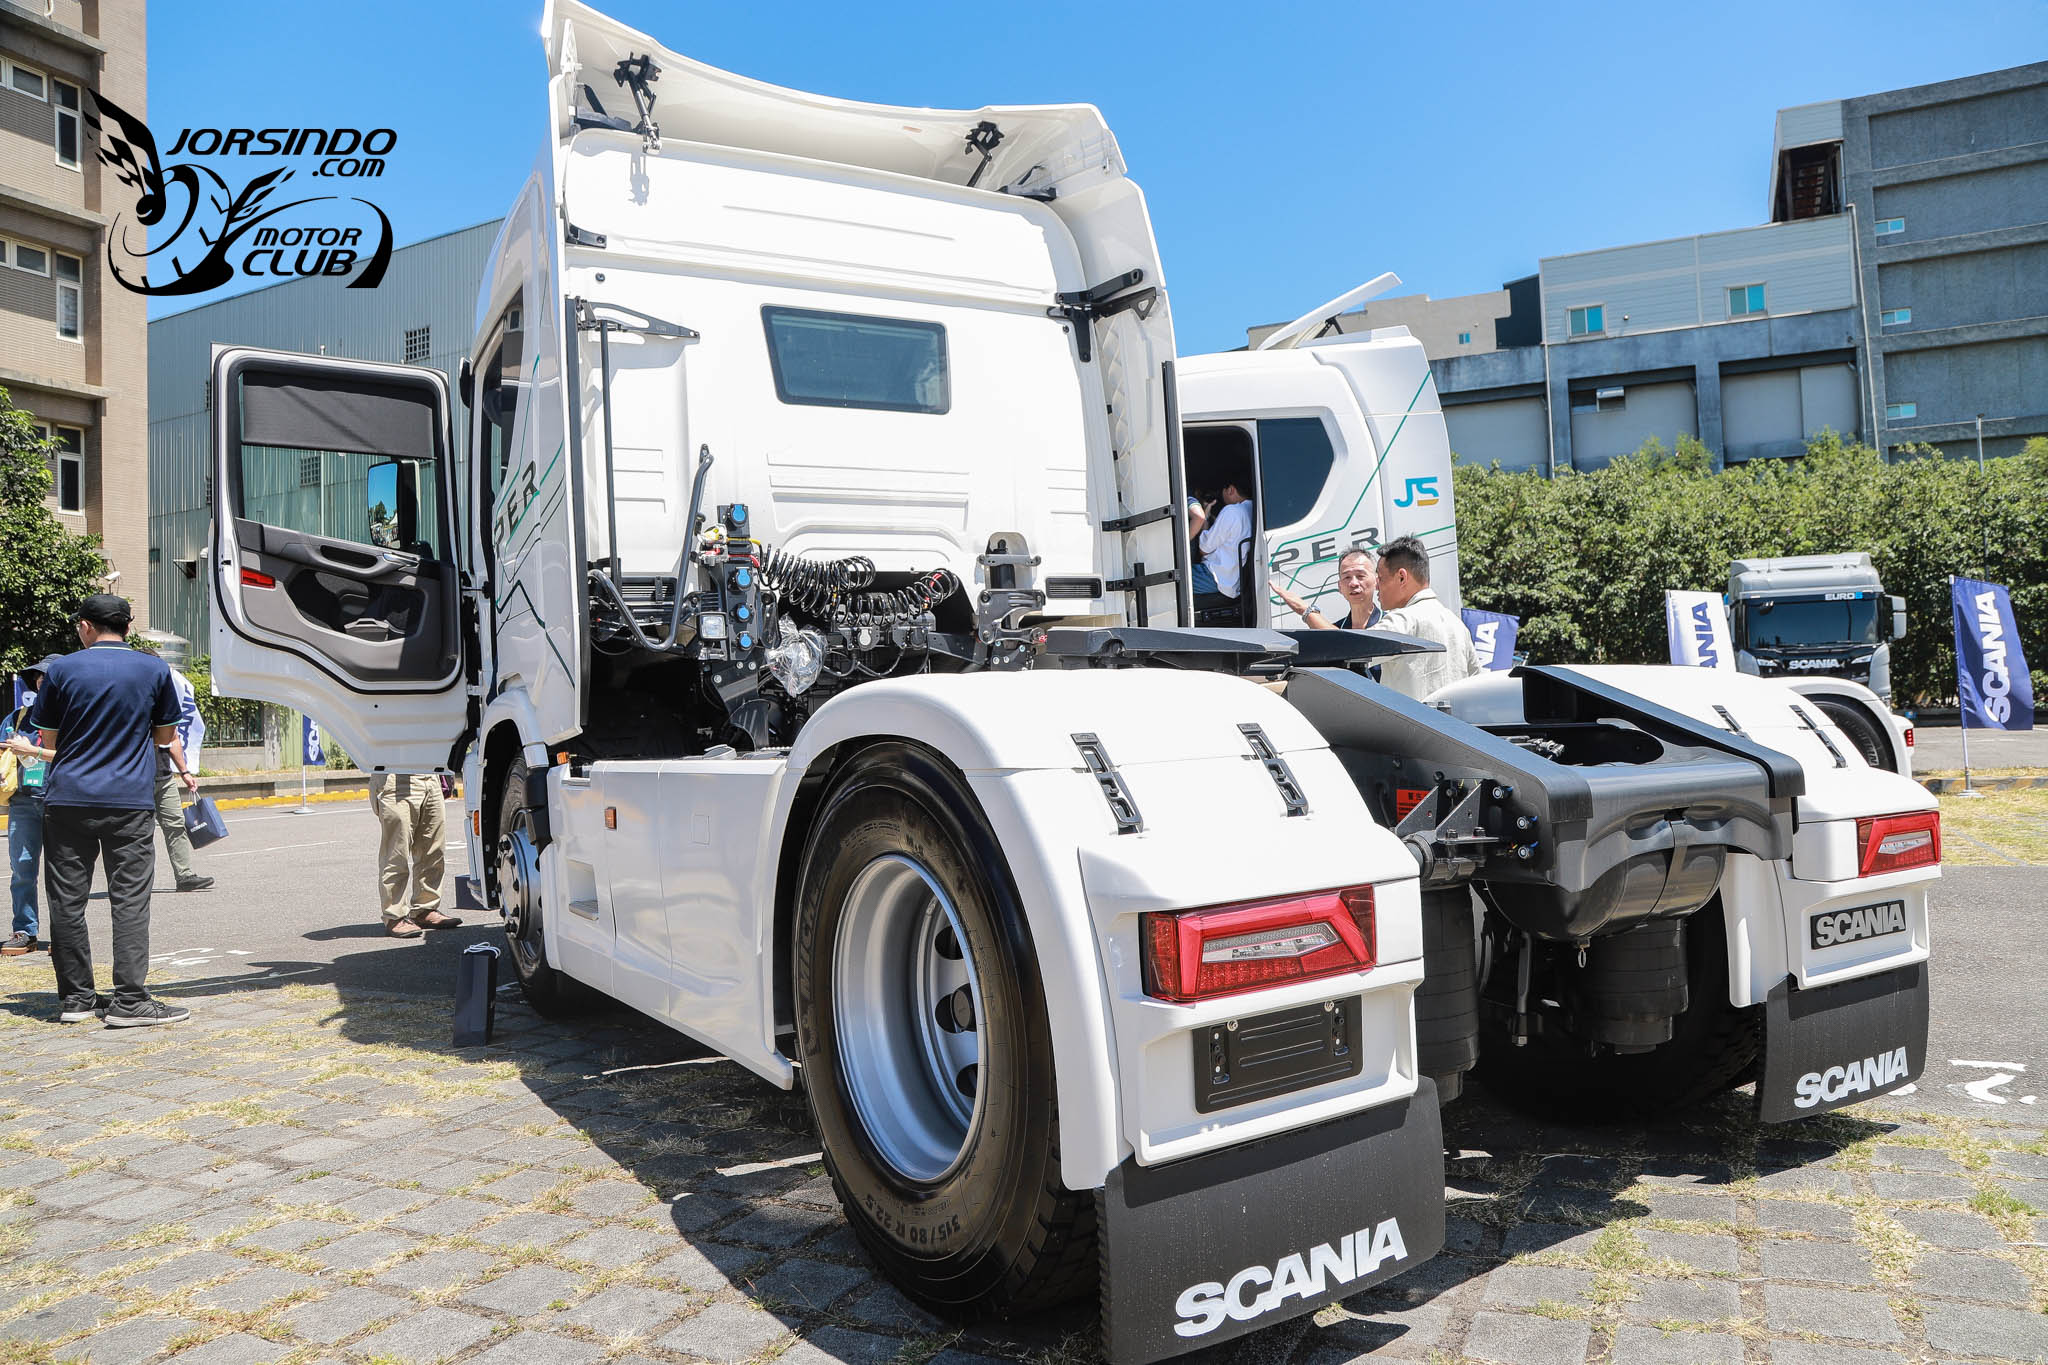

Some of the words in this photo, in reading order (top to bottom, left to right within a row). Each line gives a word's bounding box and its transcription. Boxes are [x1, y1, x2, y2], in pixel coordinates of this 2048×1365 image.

[1393, 476, 1440, 508] JS
[1788, 658, 1841, 670] SCANIA
[1974, 590, 2012, 724] SCANIA
[1815, 903, 1907, 947] SCANIA
[1794, 1046, 1909, 1109] SCANIA
[1173, 1216, 1409, 1338] SCANIA
